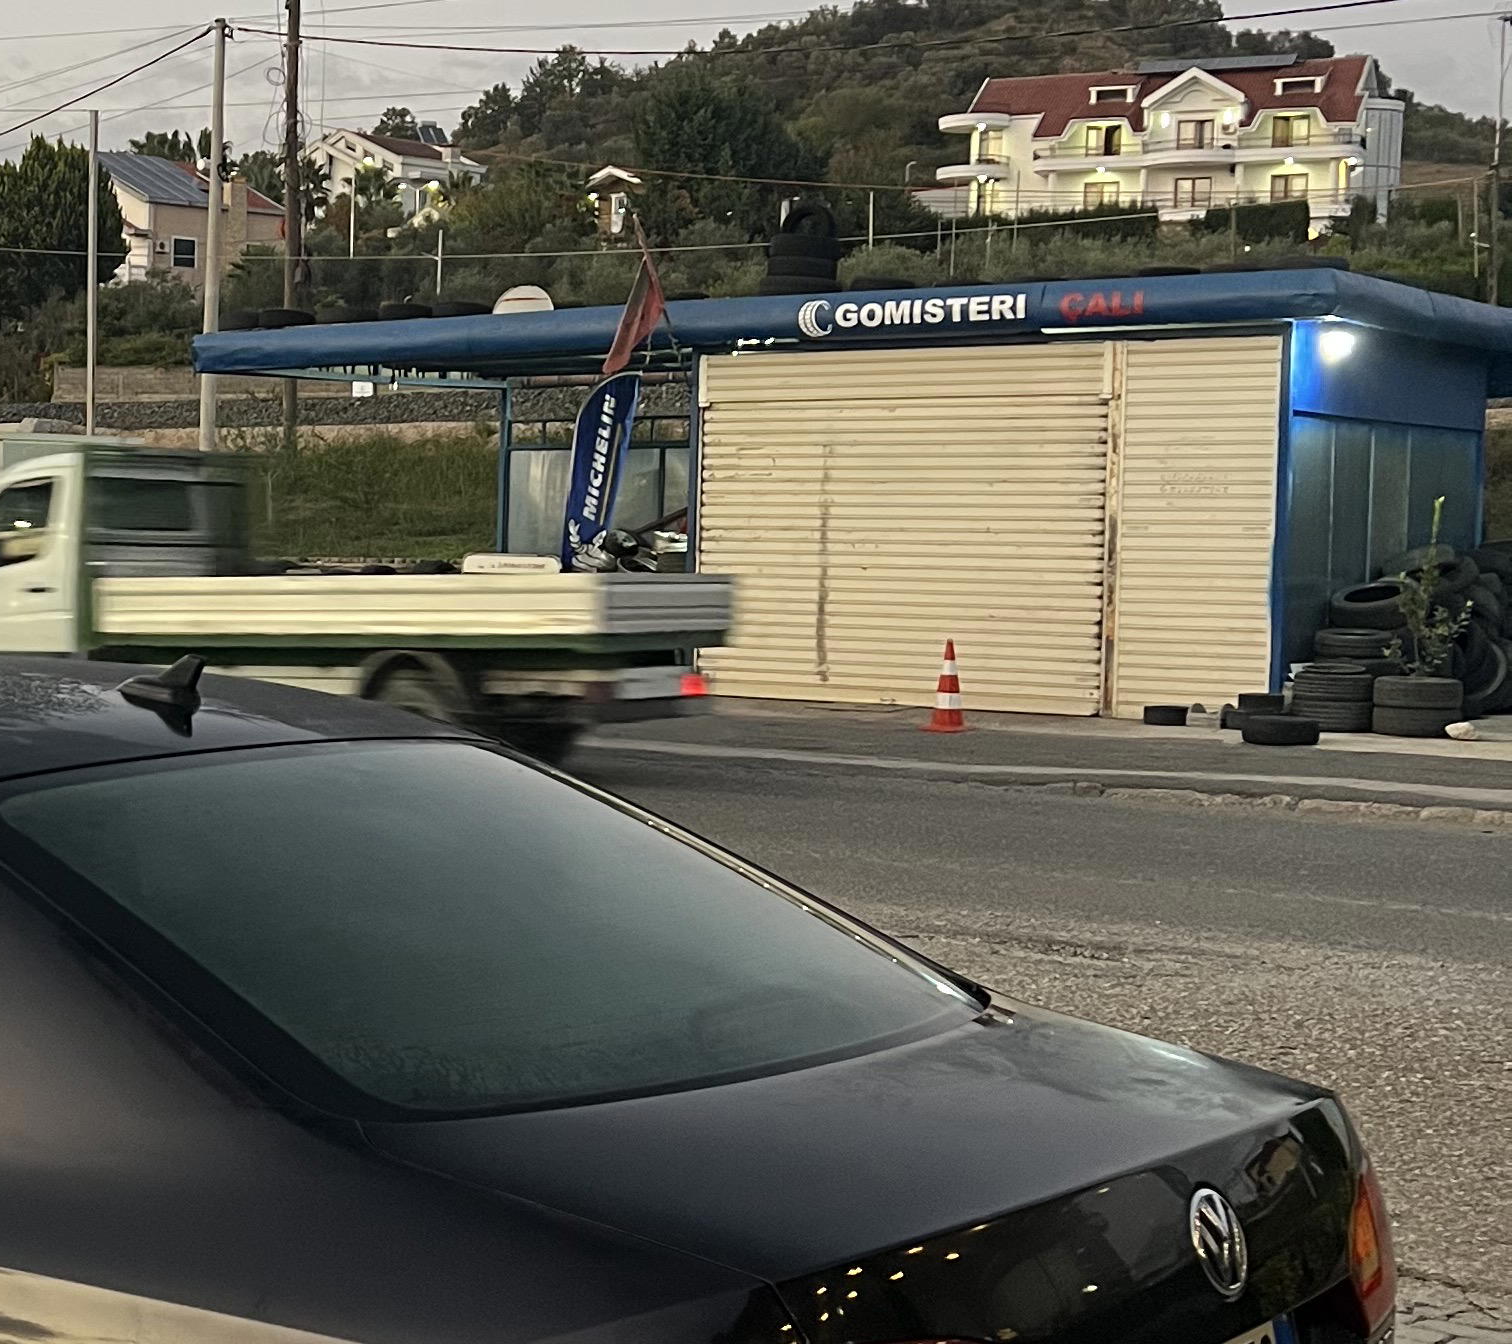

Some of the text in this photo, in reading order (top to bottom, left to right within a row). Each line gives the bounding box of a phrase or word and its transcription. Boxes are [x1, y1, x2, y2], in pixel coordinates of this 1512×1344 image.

[835, 290, 1145, 328] GOMISTERI ÇALI
[582, 393, 617, 522] MICHELIN
